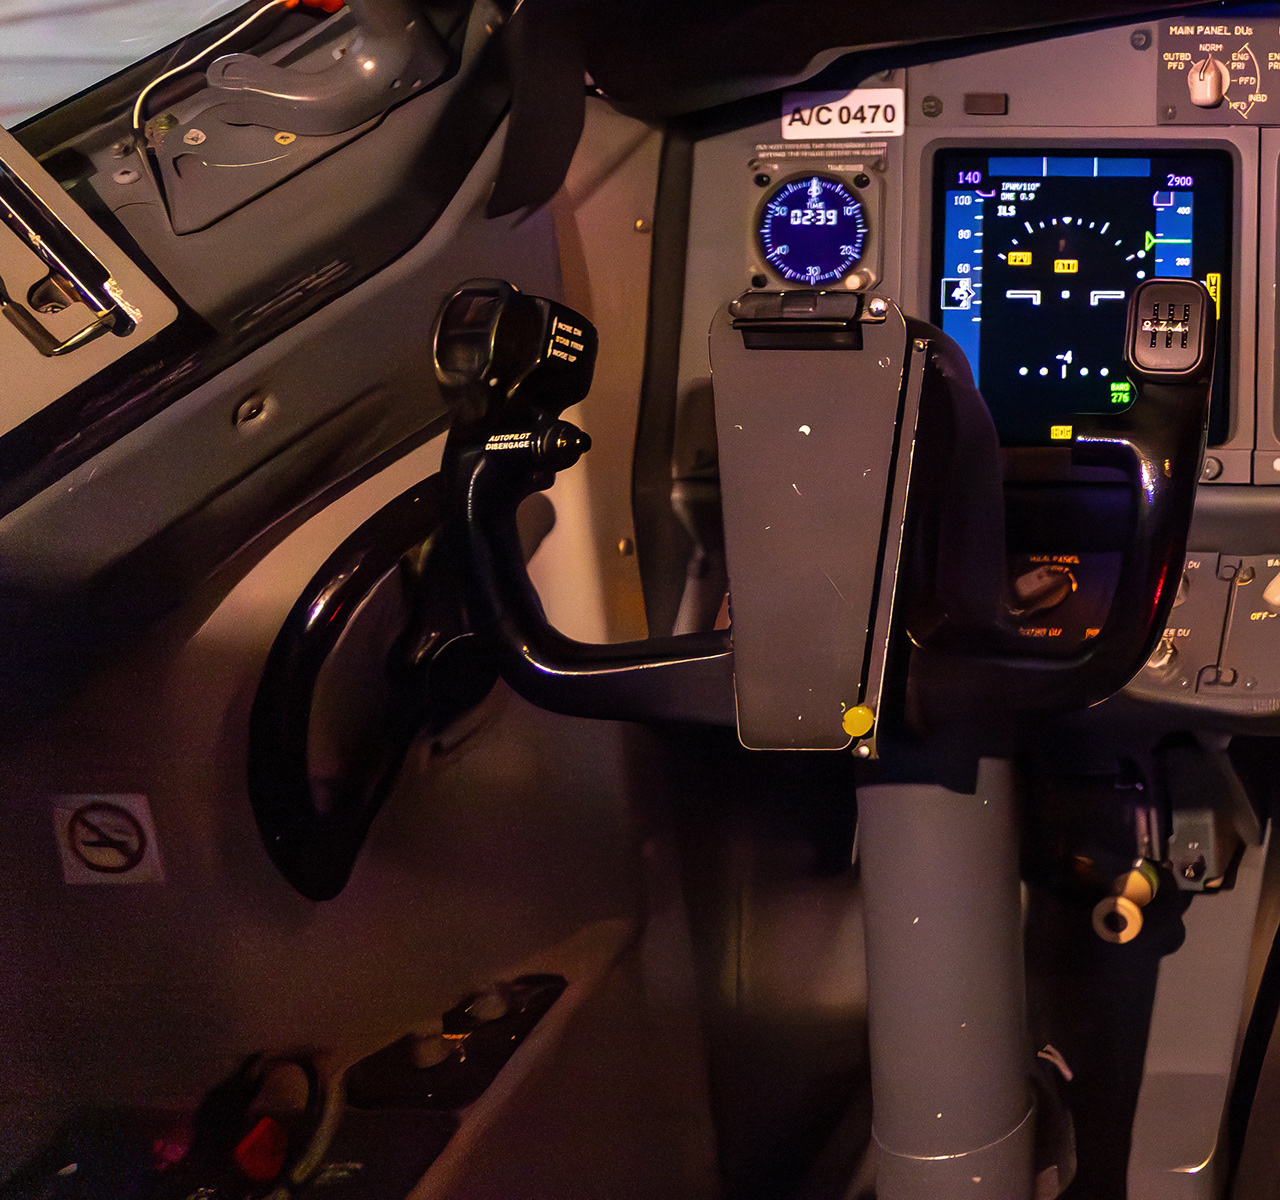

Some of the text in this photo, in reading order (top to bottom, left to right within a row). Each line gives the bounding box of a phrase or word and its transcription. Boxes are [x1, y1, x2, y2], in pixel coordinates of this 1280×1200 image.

[1170, 26, 1253, 35] MAIN PANEL DUs
[788, 104, 896, 127] A/C 0470
[958, 172, 981, 184] 140
[1167, 175, 1193, 186] 2900
[790, 209, 837, 226] 02:39
[488, 432, 531, 442] AUTOPILOT
[486, 440, 529, 450] DISENGAGE
